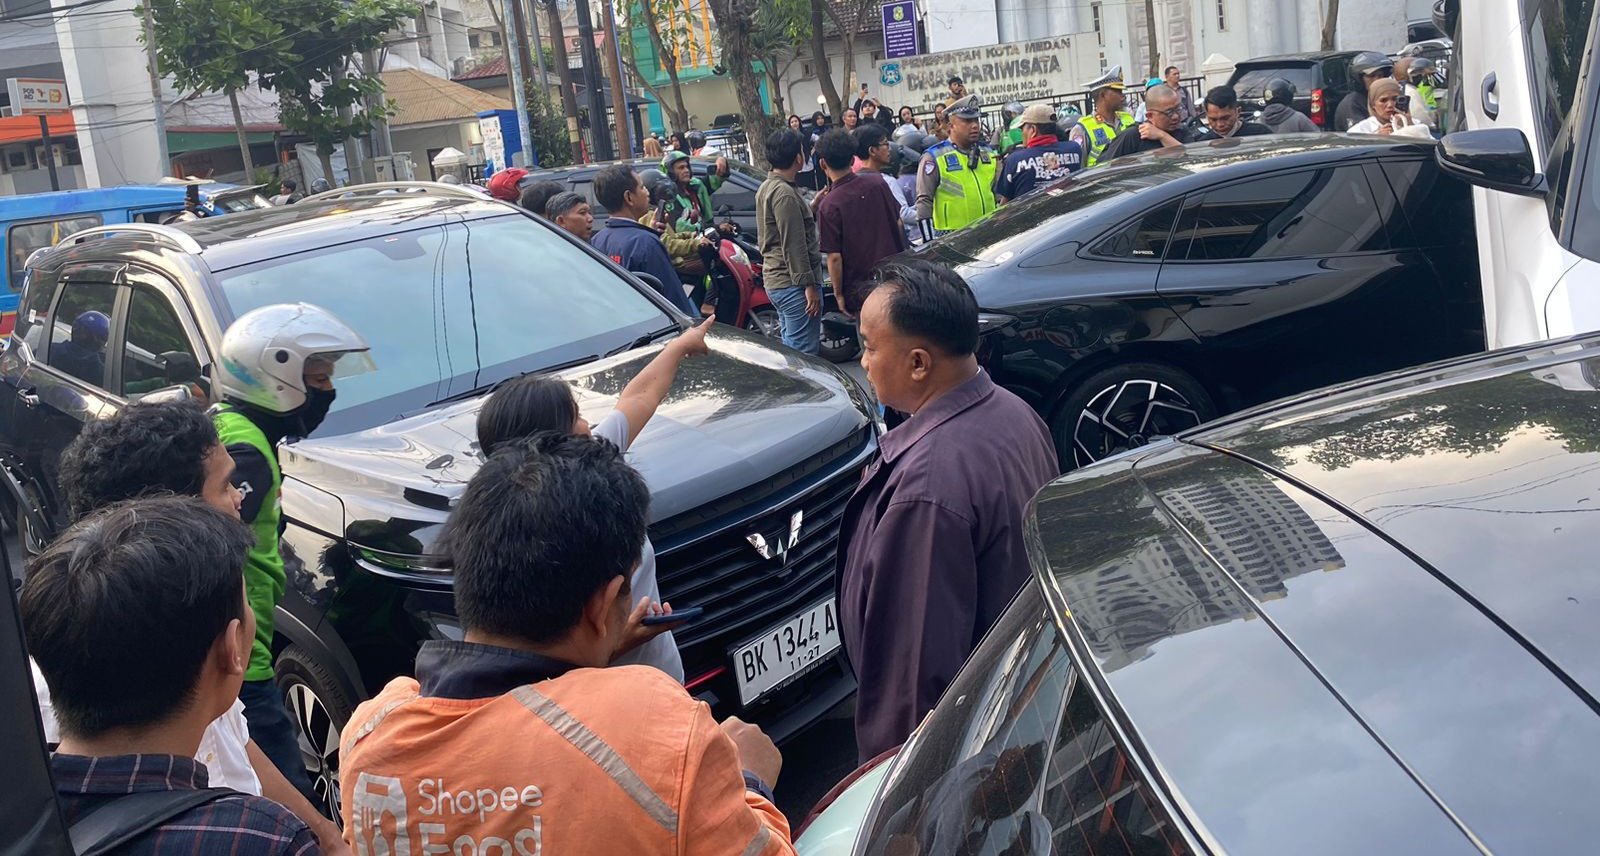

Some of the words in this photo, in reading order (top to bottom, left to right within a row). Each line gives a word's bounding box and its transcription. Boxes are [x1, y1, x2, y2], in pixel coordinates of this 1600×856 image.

[986, 44, 1021, 59] KOTA
[1025, 38, 1071, 54] MEDAN
[961, 55, 1062, 84] PARIWISATA
[741, 641, 768, 683] BK
[772, 611, 820, 662] 1344
[417, 778, 544, 823] Shopee
